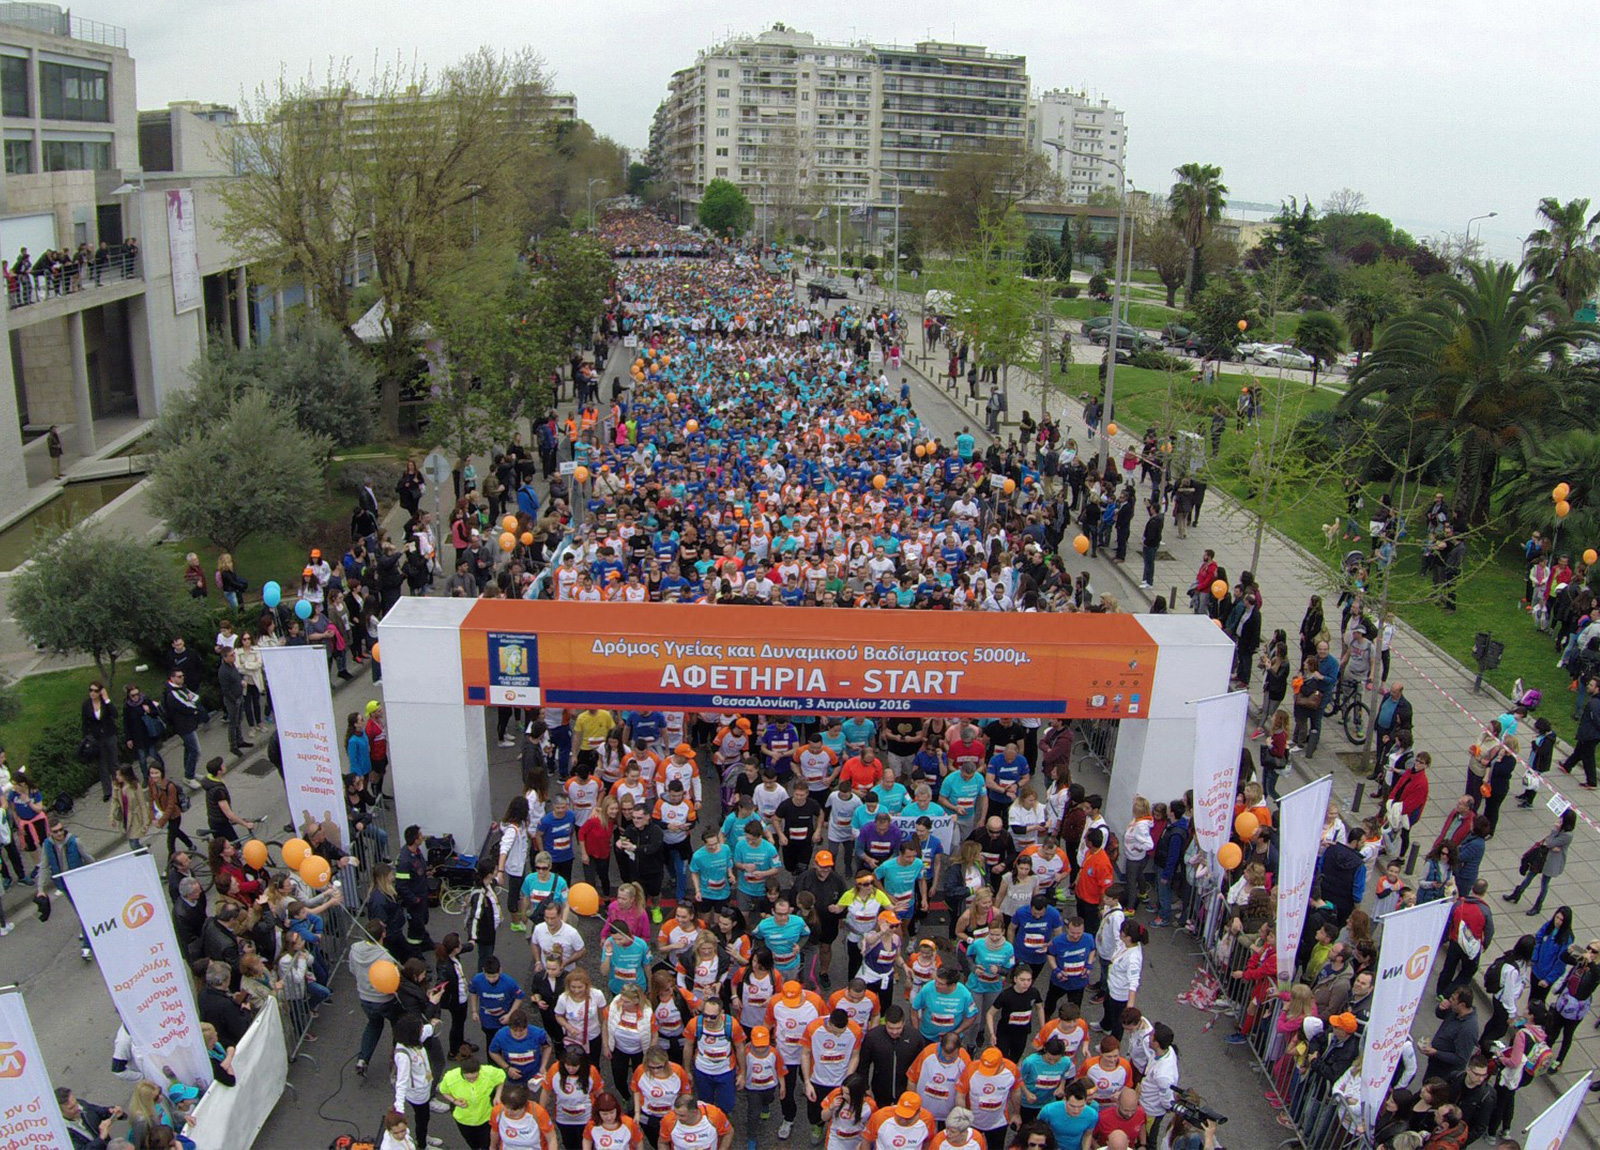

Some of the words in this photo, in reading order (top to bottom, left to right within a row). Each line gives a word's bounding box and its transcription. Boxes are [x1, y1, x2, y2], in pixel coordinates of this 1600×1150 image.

[592, 639, 660, 657] Δρόμος
[664, 641, 722, 659] Υγείας
[727, 645, 756, 658] και
[760, 643, 858, 662] Δυναμικού
[863, 646, 968, 665] Βαδίσματος
[973, 648, 1031, 666] 5000μ.
[660, 664, 827, 692] ΑΦΕΤΗΡΙΑ
[863, 669, 965, 694] START
[712, 695, 802, 710] Θεσσαλονίκη,
[805, 698, 814, 708] 3
[816, 699, 876, 711] Απριλίου
[879, 699, 911, 711] 2016
